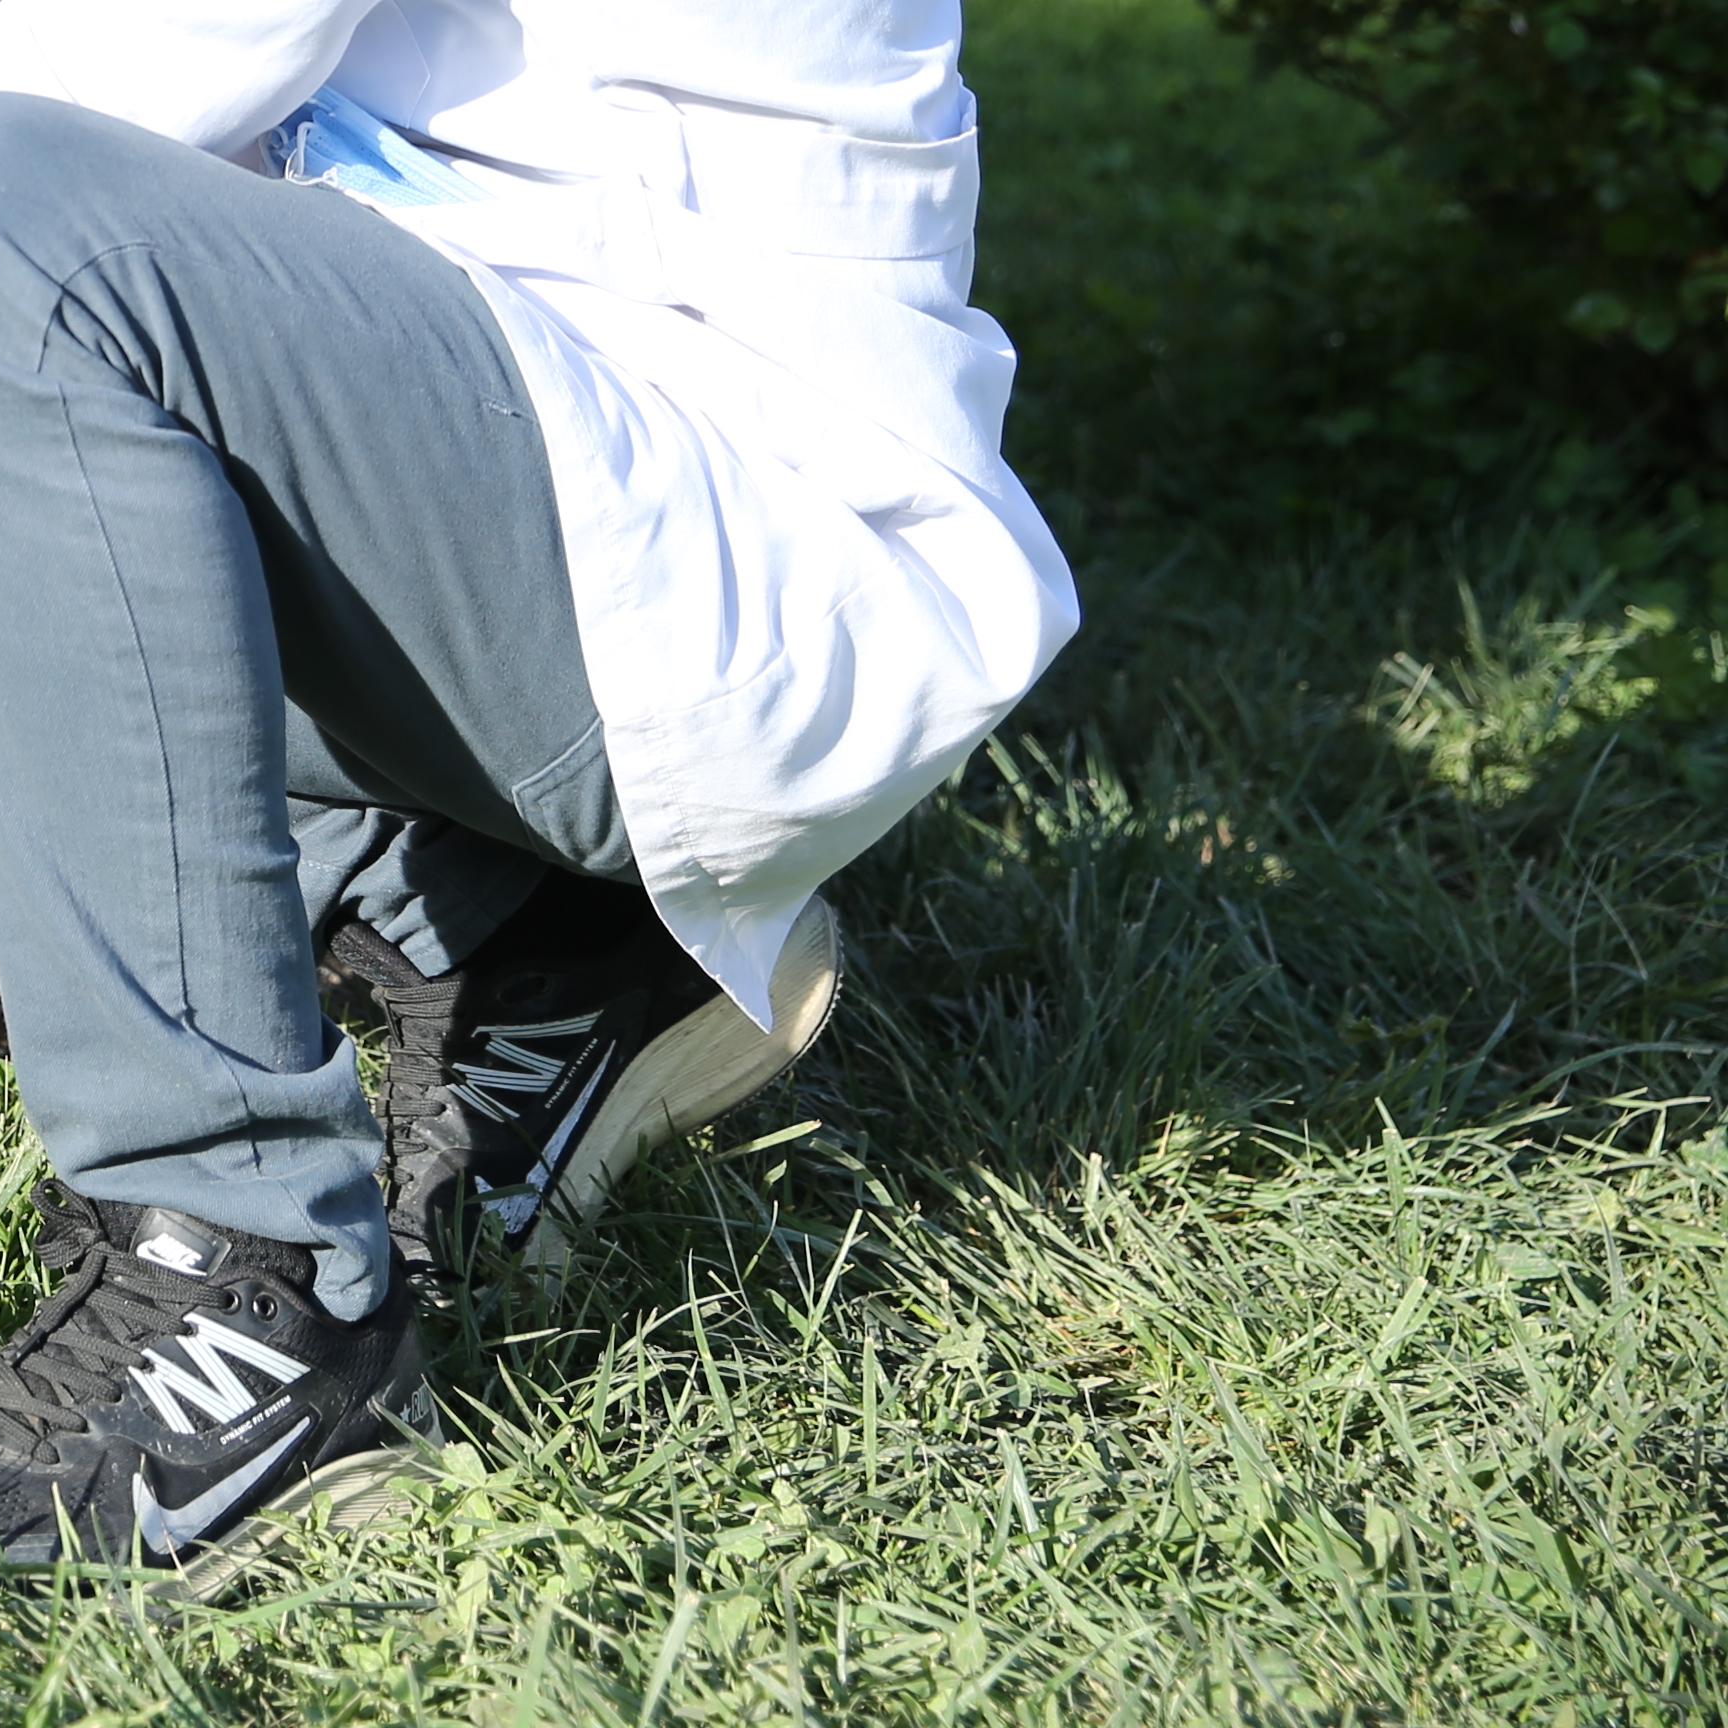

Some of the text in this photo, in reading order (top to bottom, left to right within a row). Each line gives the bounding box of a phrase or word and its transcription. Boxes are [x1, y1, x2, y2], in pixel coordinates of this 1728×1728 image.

[147, 1232, 203, 1266] NIKE
[219, 1394, 292, 1446] DYNAMIC FIT SYSTEM
